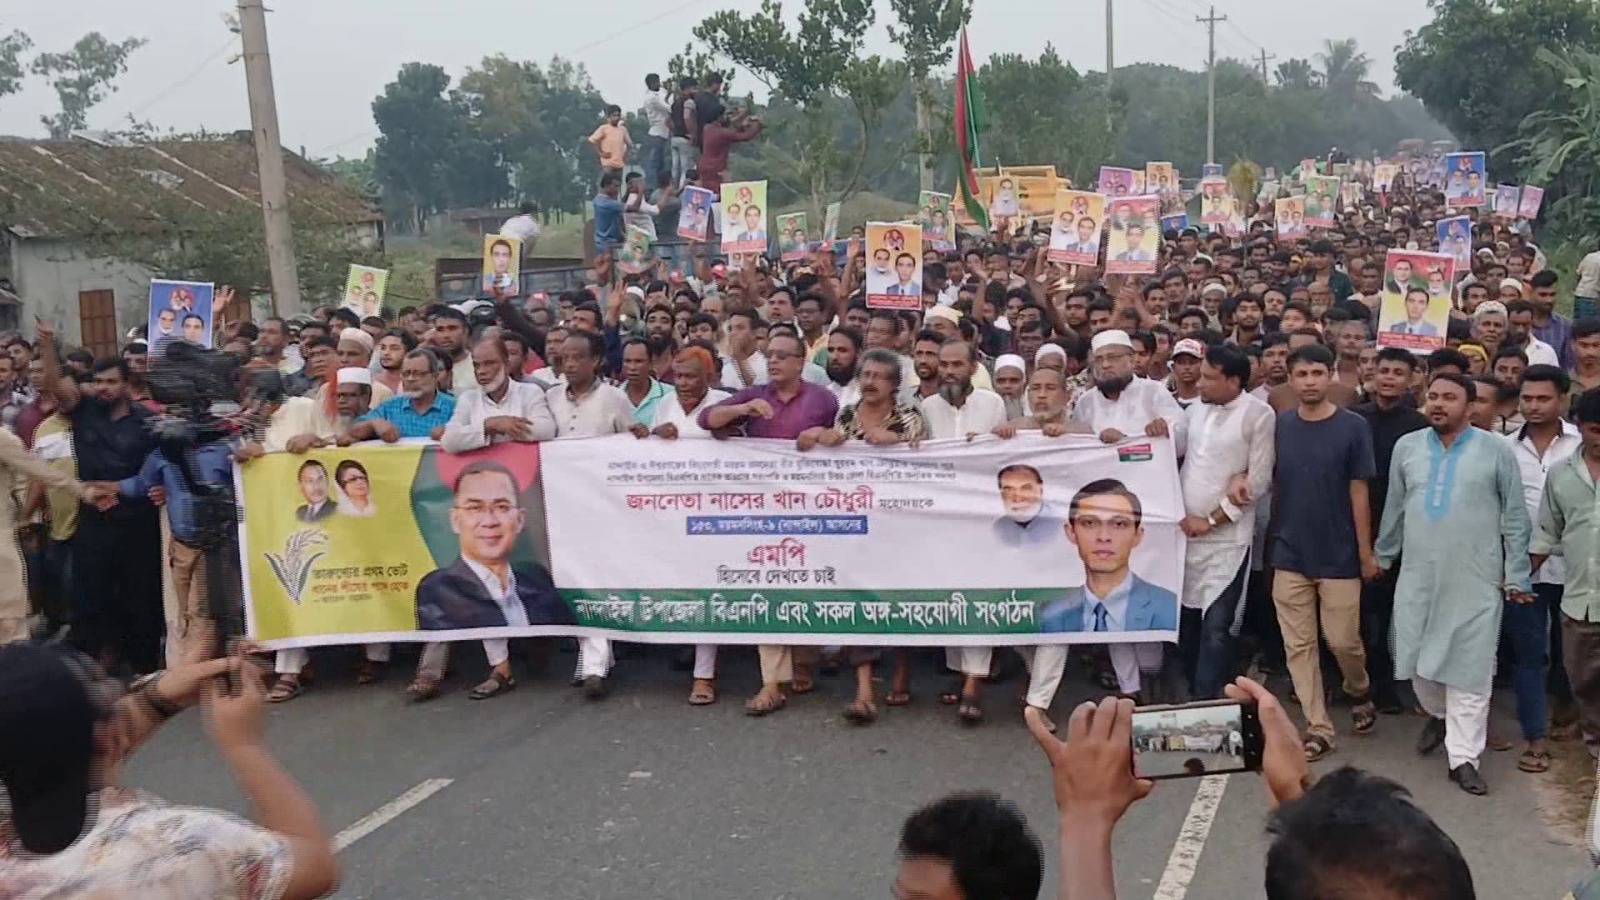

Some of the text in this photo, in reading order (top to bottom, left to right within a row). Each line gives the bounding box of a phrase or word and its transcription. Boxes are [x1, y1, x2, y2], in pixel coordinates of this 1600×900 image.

[625, 492, 701, 510] জননেতা
[708, 491, 765, 509] নাসের
[773, 491, 806, 510] খান
[814, 485, 873, 513] চৌধুরী
[747, 537, 806, 567] এমপি
[717, 564, 836, 584] হিসেবে দেখতে চাই
[710, 592, 769, 625] বিএনপি
[776, 602, 811, 626] এবং
[814, 599, 856, 626] সকল
[862, 592, 968, 626] অঙ্গ-সহযোগী
[974, 591, 1035, 626] সংগঠন
